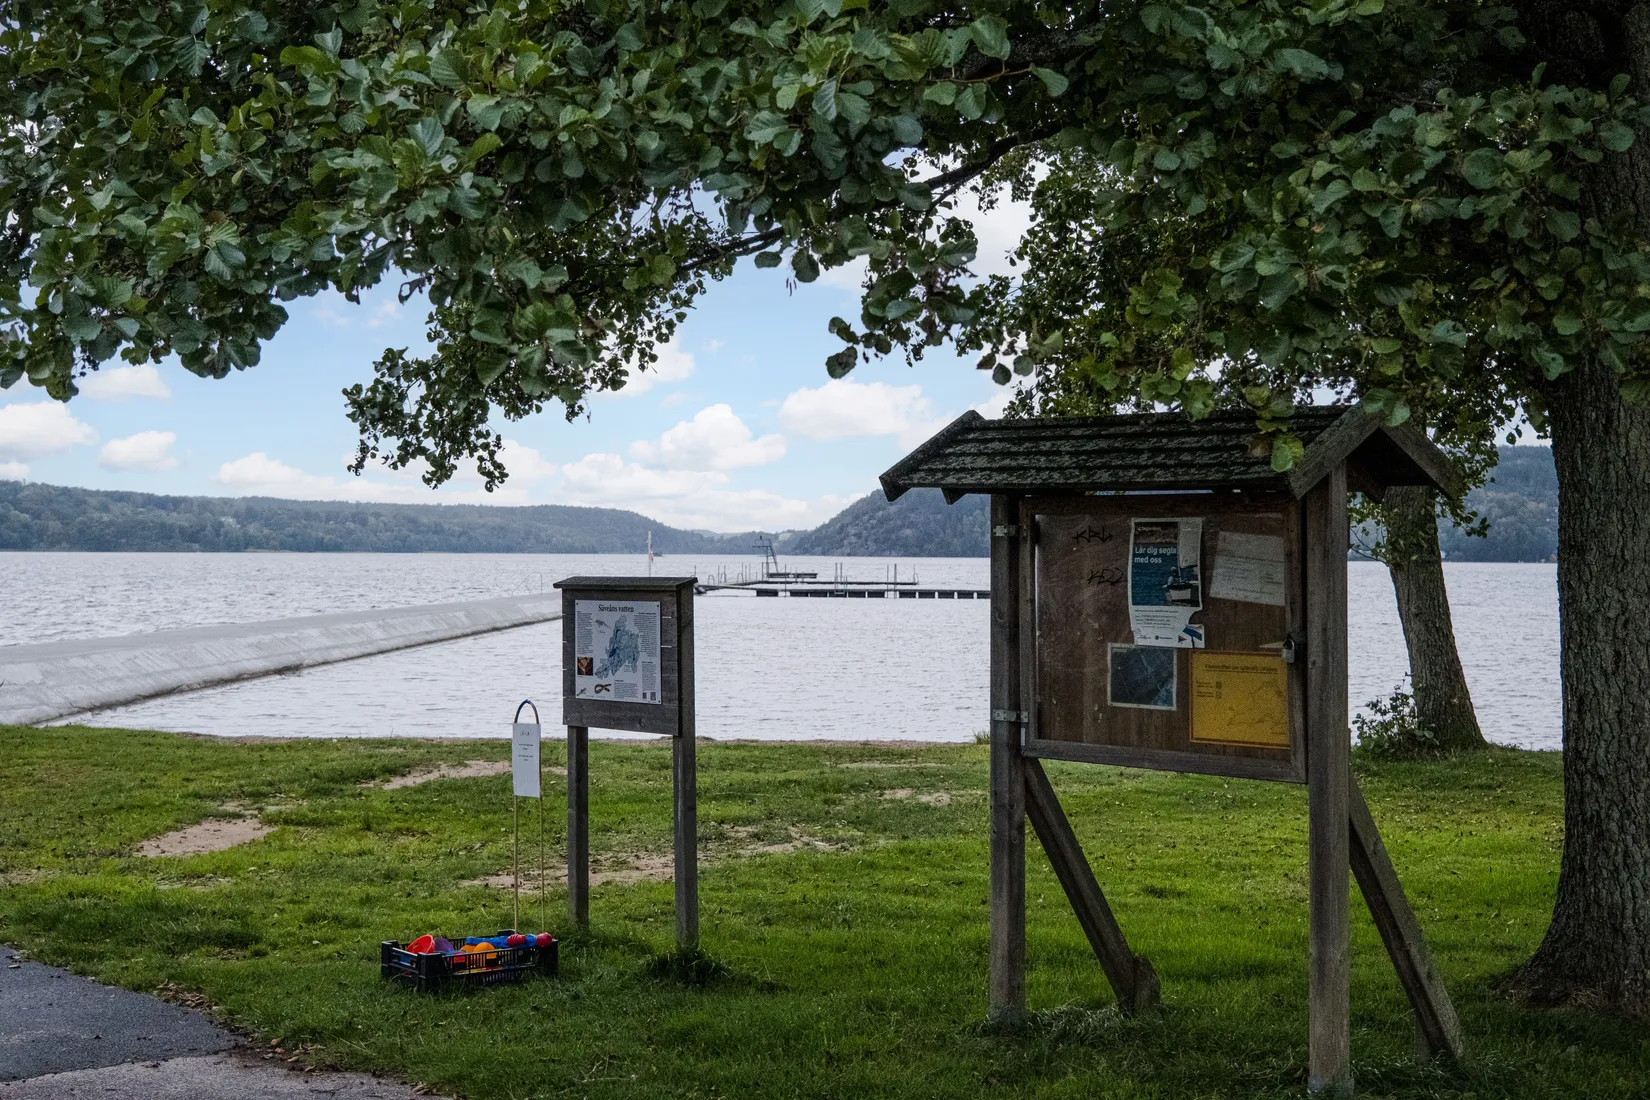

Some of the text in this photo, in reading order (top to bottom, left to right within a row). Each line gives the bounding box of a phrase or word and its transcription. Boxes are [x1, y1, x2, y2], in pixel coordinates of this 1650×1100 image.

[1147, 547, 1157, 555] dig
[1159, 547, 1176, 555] segla
[598, 603, 618, 612] Säveåns
